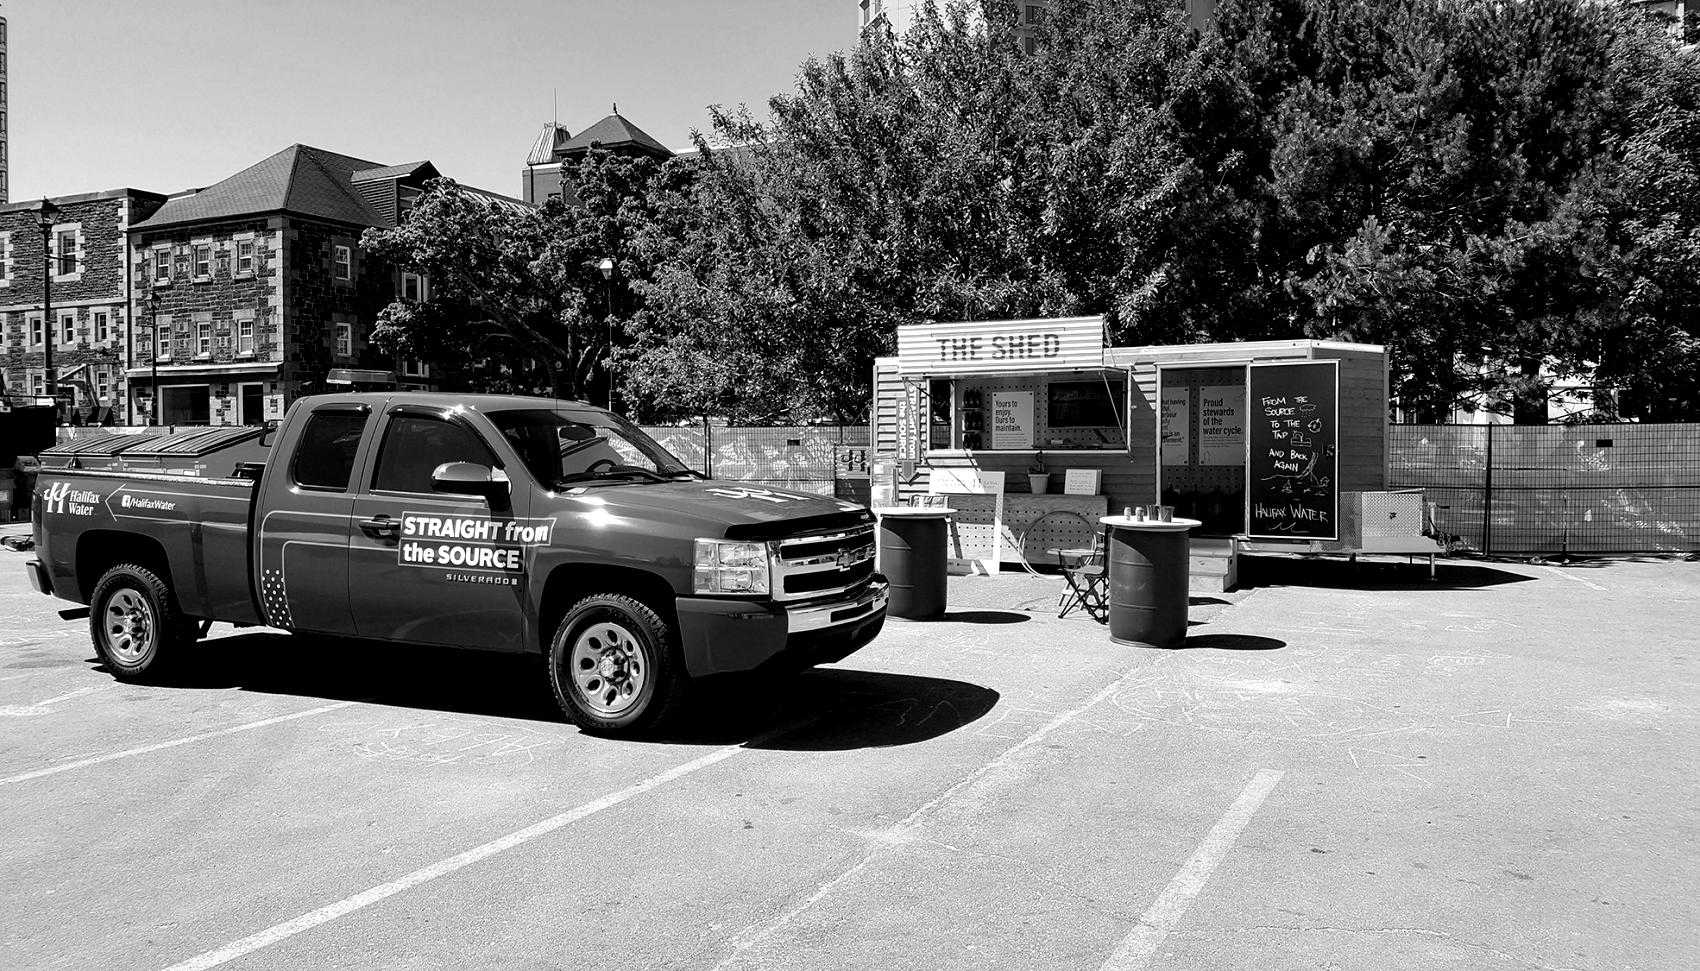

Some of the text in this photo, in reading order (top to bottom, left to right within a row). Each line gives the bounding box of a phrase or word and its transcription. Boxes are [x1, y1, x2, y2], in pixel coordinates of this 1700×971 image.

[936, 333, 1060, 361] THE SHED
[995, 400, 1018, 408] Yours to
[1203, 397, 1224, 407] Proud
[1262, 396, 1286, 406] FROM
[1202, 407, 1235, 417] stewards
[1264, 407, 1296, 416] SOURCE
[1009, 416, 1016, 424] to
[1202, 417, 1223, 426] of the
[1270, 419, 1301, 428] TO THE
[899, 401, 907, 460] the SOURCE
[1202, 426, 1222, 435] water
[1272, 429, 1289, 440] TAP
[908, 436, 918, 459] from
[1268, 448, 1308, 460] AND BACK
[1273, 460, 1299, 472] AGAIN
[69, 489, 100, 504] Halifax
[68, 502, 94, 516] Water
[1255, 502, 1329, 524] HALIFAX WATER
[403, 516, 549, 543] STRAIGHT from
[402, 542, 520, 569] the SOURCE
[446, 573, 509, 585] SILVERADO
